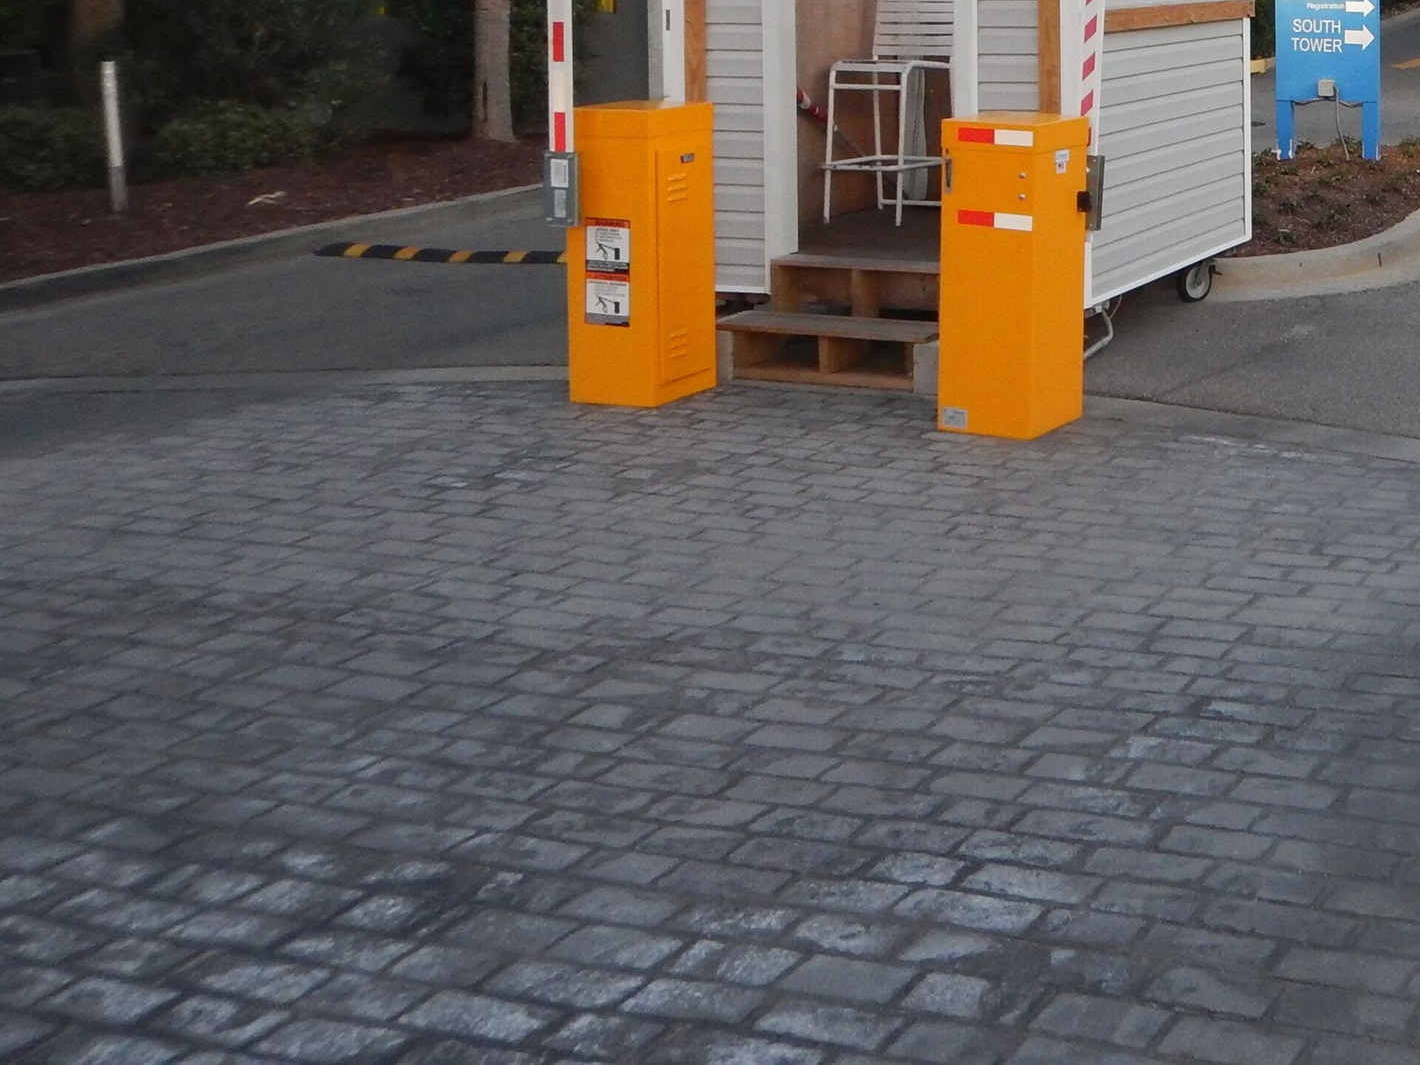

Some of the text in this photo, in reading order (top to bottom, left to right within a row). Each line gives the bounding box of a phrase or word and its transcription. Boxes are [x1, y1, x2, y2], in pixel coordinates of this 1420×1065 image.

[1306, 2, 1345, 11] Registration
[1292, 18, 1341, 34] SOUTH
[1291, 37, 1343, 53] TOWER
